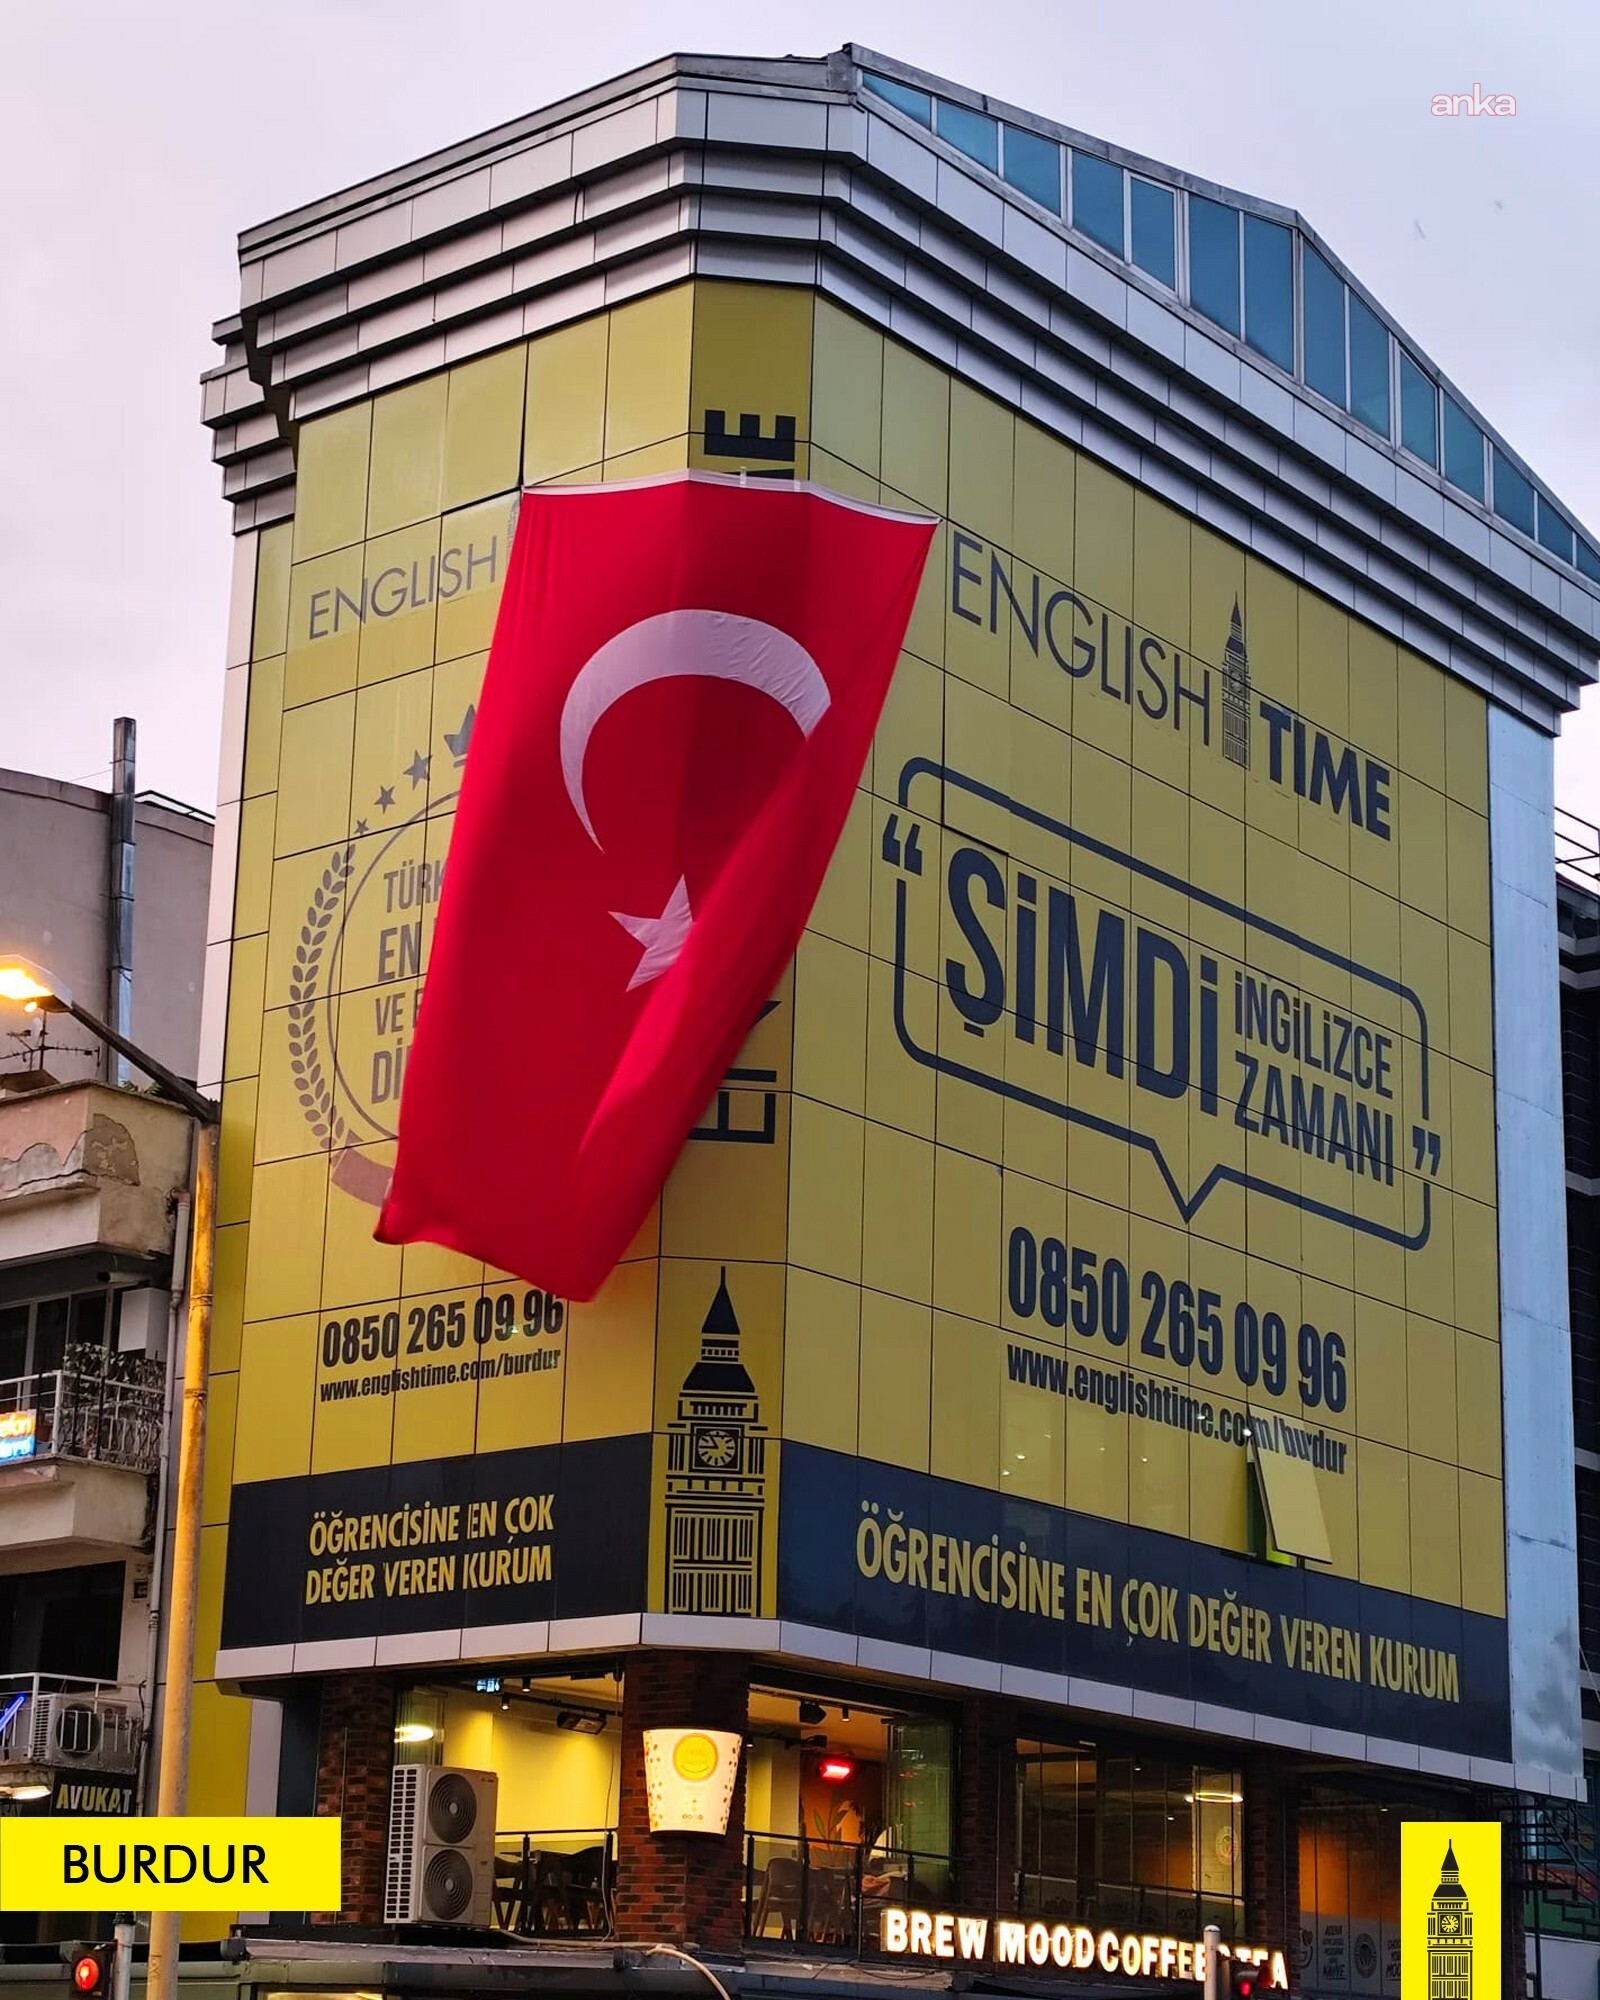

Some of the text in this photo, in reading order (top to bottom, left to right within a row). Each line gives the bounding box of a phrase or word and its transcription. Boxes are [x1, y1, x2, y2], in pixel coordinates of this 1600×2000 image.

[309, 536, 498, 640] ENGLISH
[951, 532, 1392, 842] ENGLISH TIME
[377, 920, 422, 983] EN
[375, 992, 406, 1036] VE
[1234, 1050, 1394, 1187] ZAMANI
[322, 1289, 564, 1368] 0850 265 09 96
[1008, 1226, 1347, 1413] 0850 265 09 96
[320, 1348, 562, 1402] www.englishtime.com/burdur
[1007, 1344, 1348, 1476] www.englishtime.com/burdur
[309, 1493, 555, 1557] ÖĞRENCİSİNE EN ÇOK
[305, 1544, 553, 1606] DEĞER VEREN KURUM
[856, 1499, 1461, 1704] ÖĞRENCİSİNE EN ÇOK DEĞER VEREN KURUM
[55, 1783, 133, 1815] AVUKAT
[884, 1908, 989, 1960] BREW
[998, 1921, 1096, 1968] MOOD
